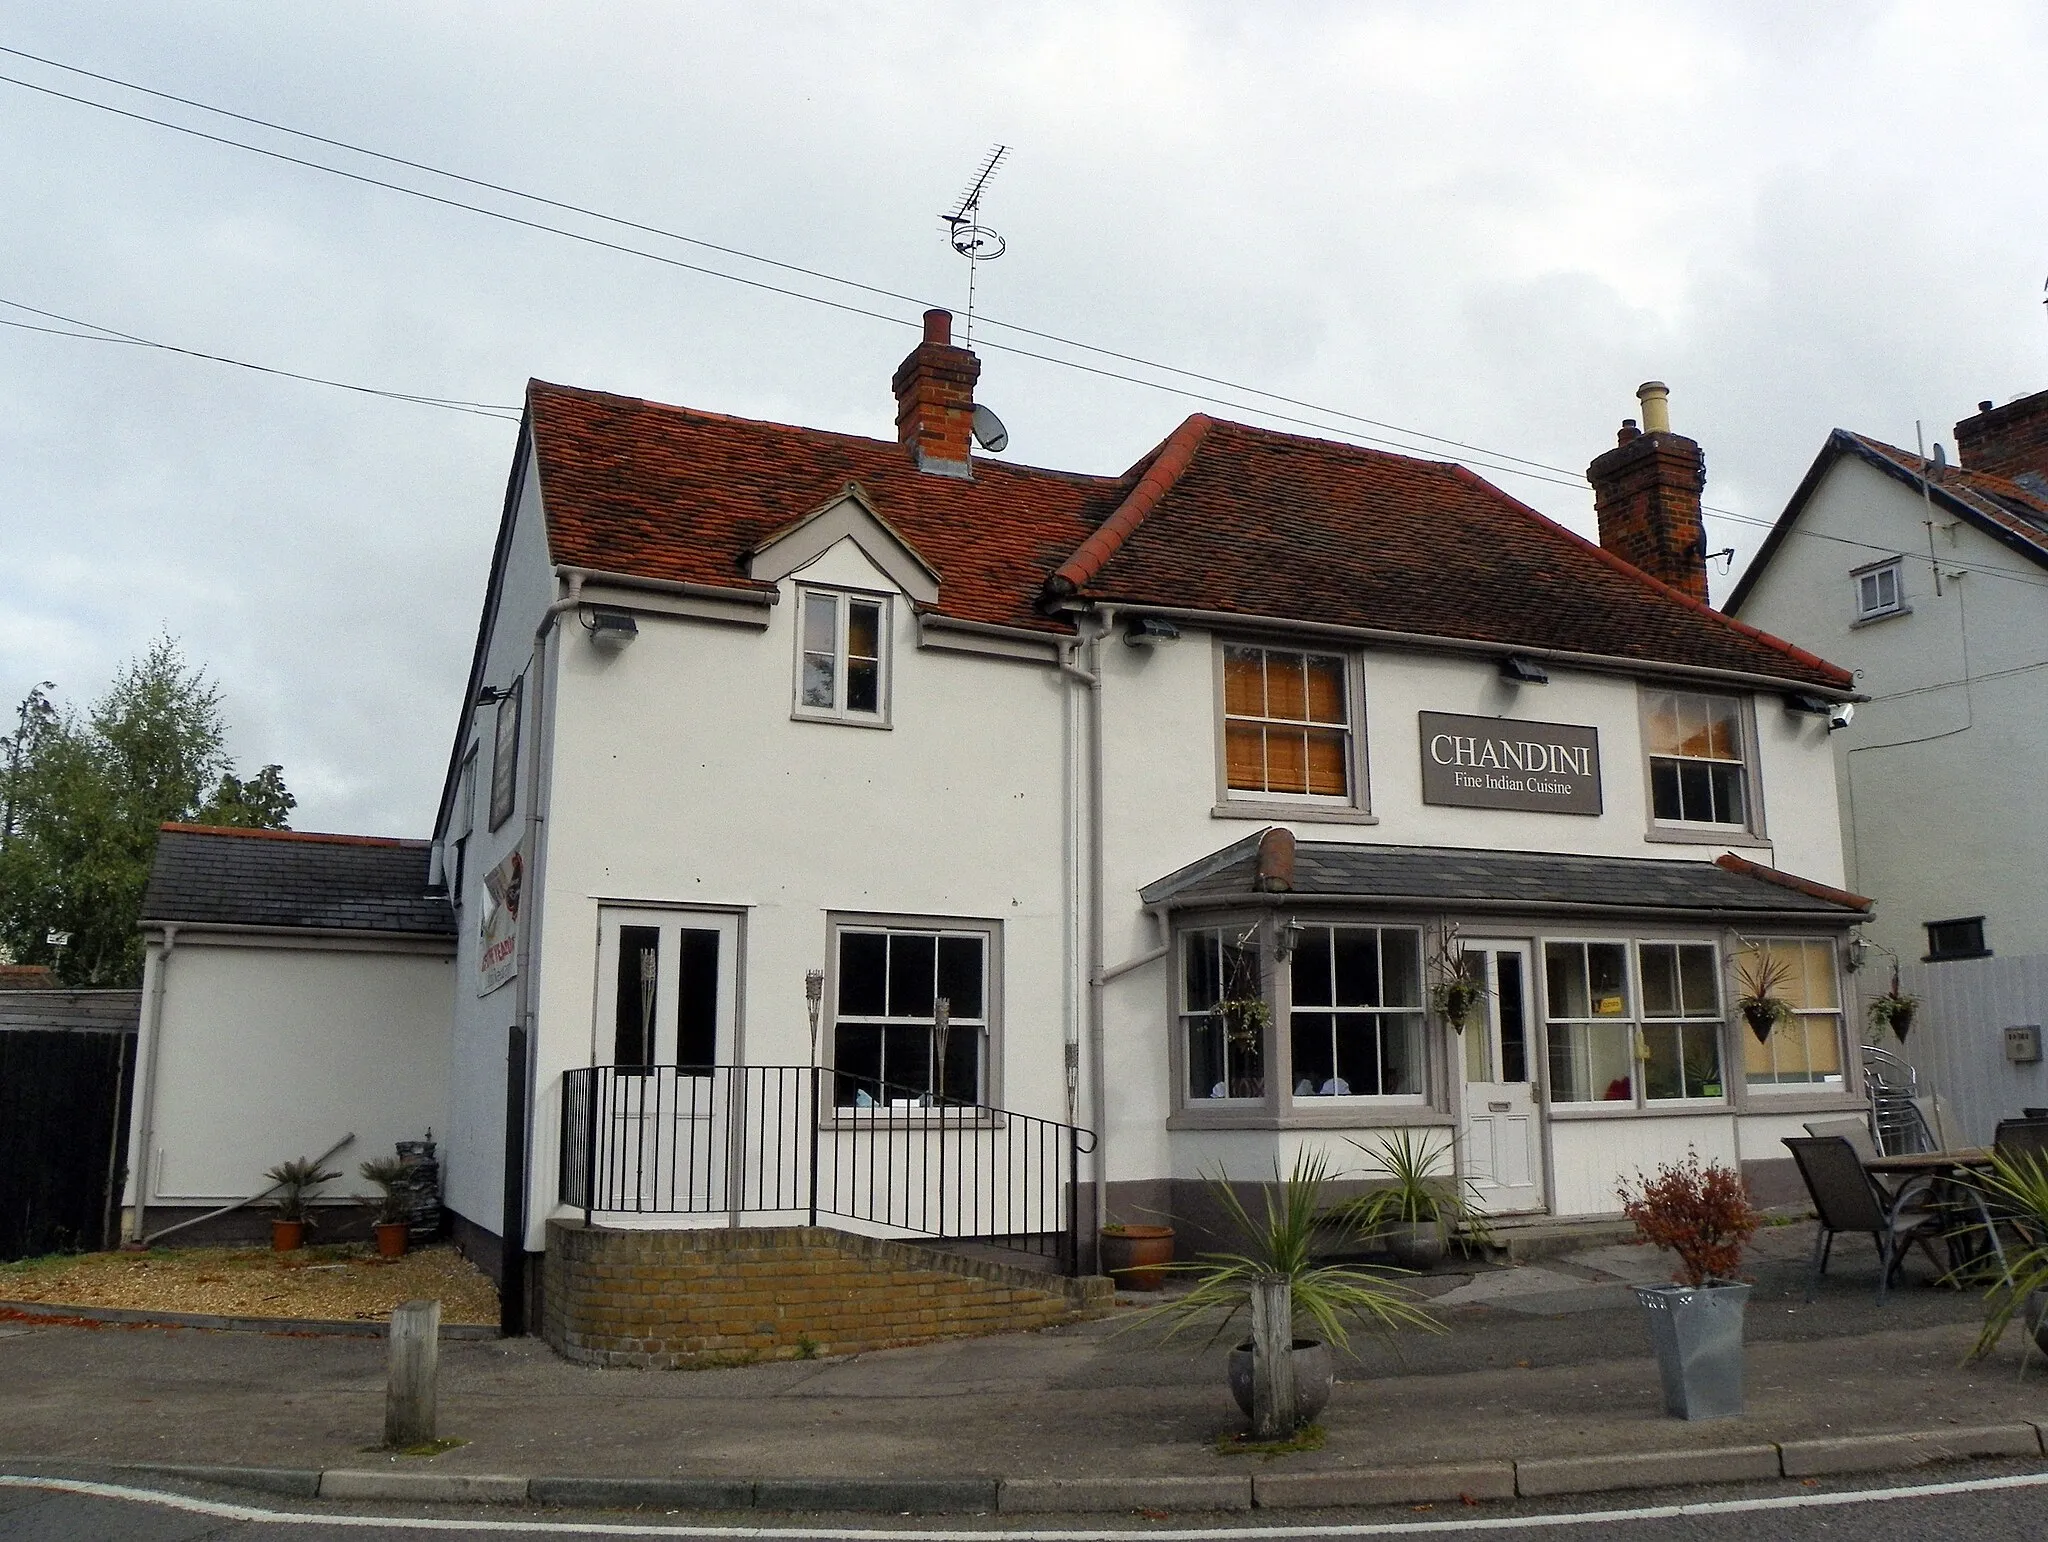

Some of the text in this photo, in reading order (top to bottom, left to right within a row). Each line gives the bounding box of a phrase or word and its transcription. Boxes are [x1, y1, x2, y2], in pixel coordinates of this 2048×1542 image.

[1430, 734, 1592, 776] CHANDINI
[1454, 771, 1572, 795] Fine Indian Cuisine
